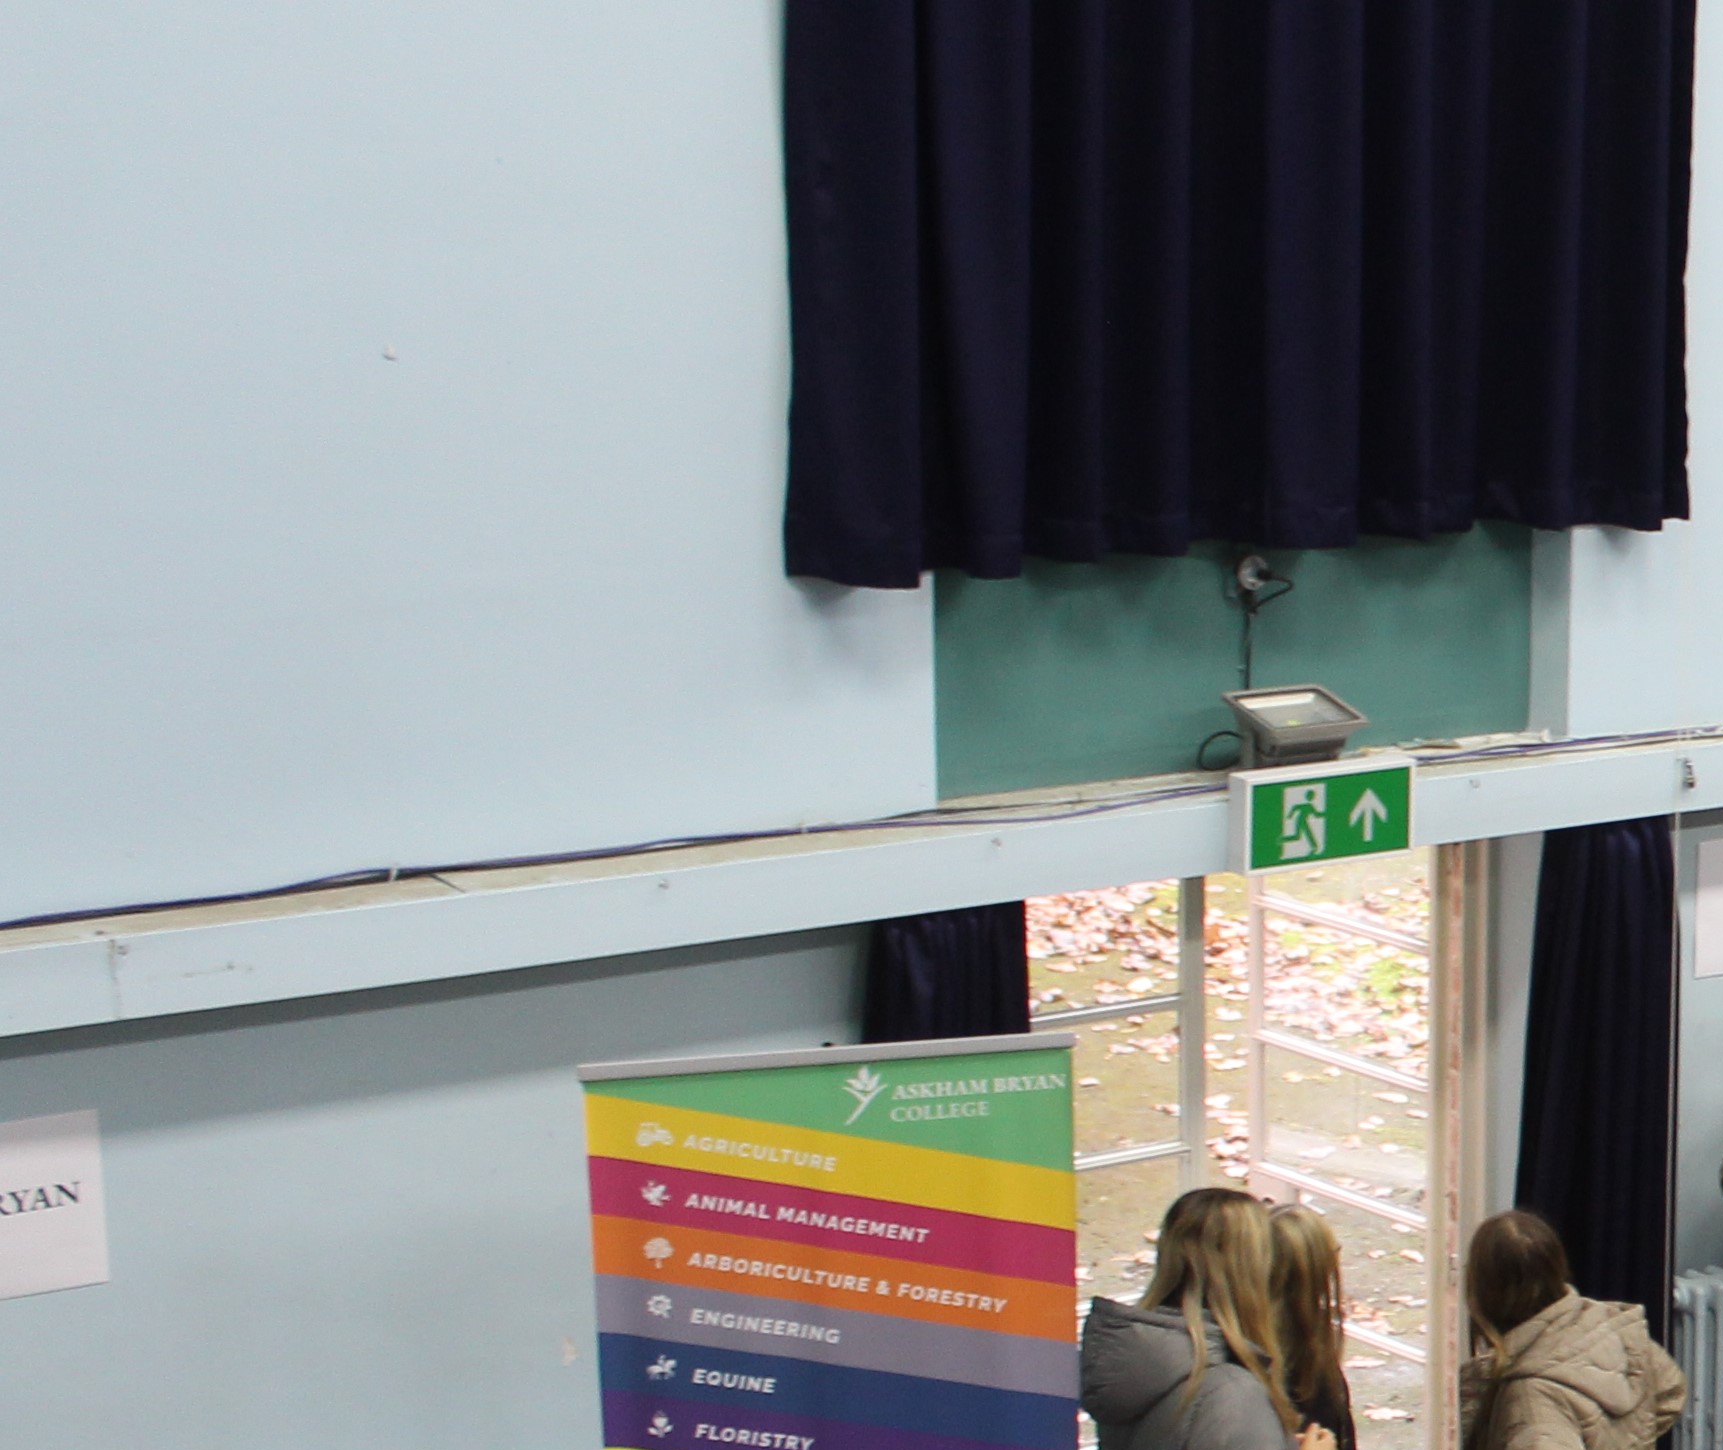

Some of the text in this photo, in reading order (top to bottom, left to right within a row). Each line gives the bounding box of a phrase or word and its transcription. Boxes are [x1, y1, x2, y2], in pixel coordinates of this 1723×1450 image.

[890, 1073, 1066, 1101] ASKHAM BRYAN
[889, 1100, 990, 1123] COLLEGE
[683, 1133, 838, 1172] AGRICULTURE
[685, 1193, 930, 1244] ANIMAL MANAGEMENT
[687, 1251, 1008, 1314] ARBORICULTURE & FORESTRY
[690, 1307, 841, 1345] ENGINEERING
[692, 1368, 777, 1395] EQUINE
